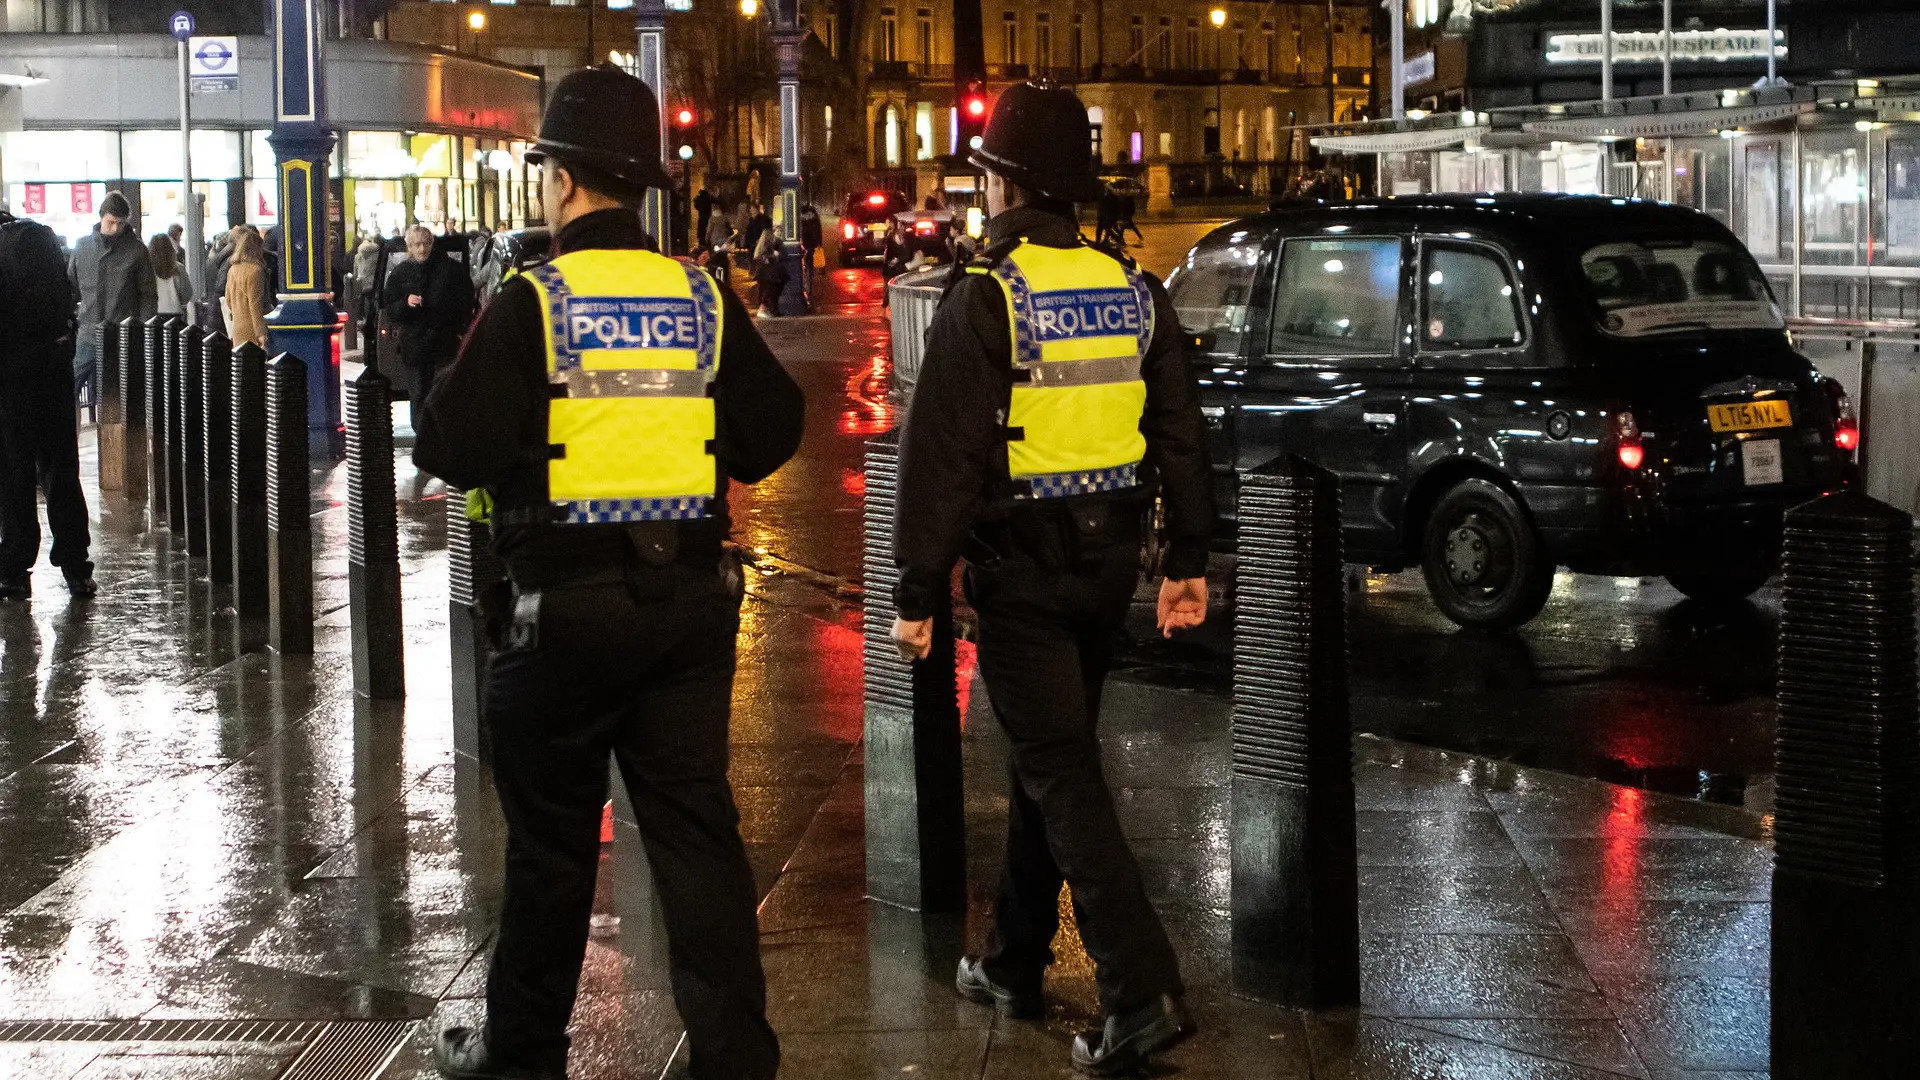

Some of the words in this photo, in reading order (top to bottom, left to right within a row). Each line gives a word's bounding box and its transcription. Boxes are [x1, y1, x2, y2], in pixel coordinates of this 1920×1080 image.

[571, 303, 619, 313] BRITISH
[621, 303, 692, 312] TRANSPORT
[1035, 295, 1076, 307] BRITISH
[1078, 293, 1132, 303] TRANSPORT
[571, 315, 695, 344] POLICE
[1037, 304, 1139, 335] POLICE
[1718, 405, 1752, 426] LT15
[1753, 404, 1783, 424] NYL
